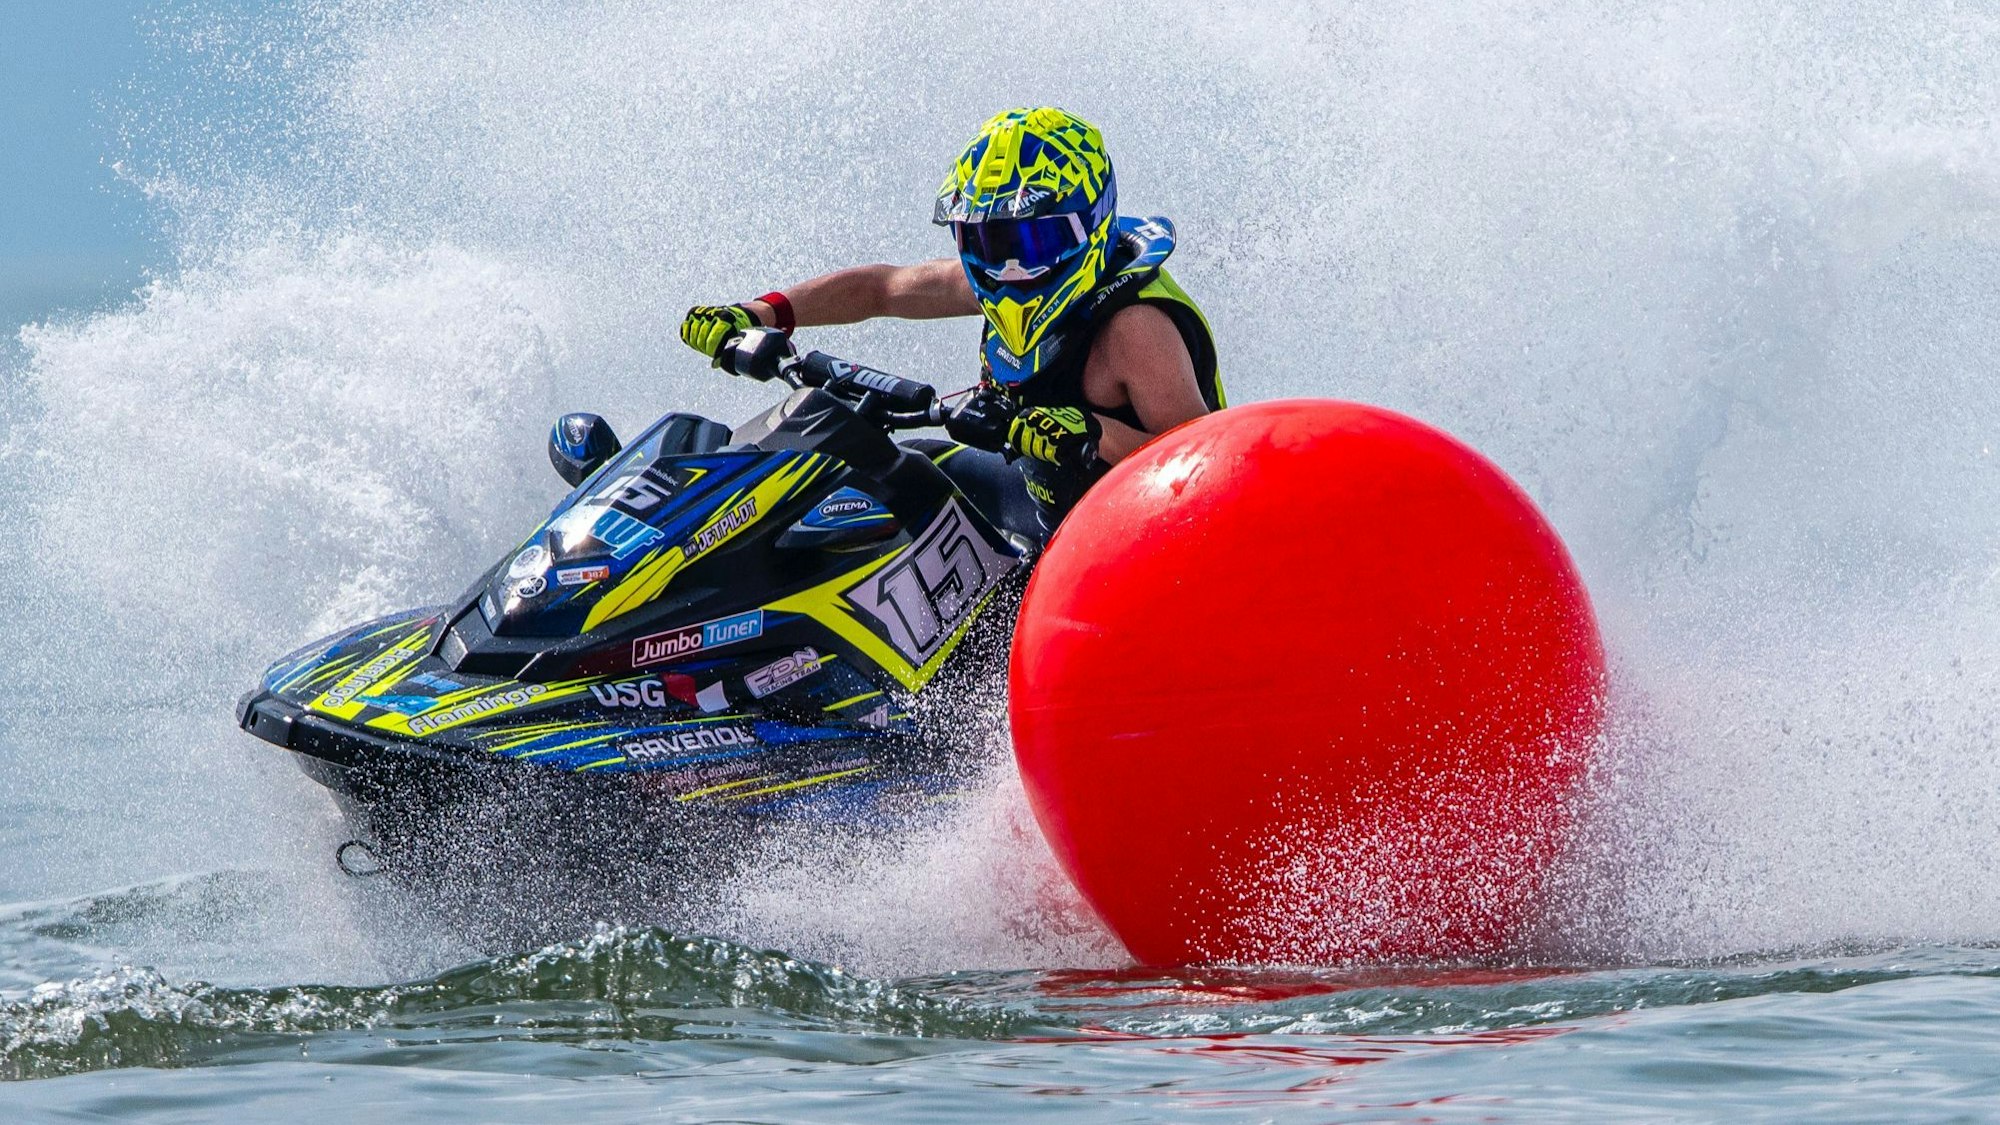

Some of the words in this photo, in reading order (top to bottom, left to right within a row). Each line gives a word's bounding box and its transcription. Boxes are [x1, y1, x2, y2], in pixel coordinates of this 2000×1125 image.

[1032, 299, 1060, 331] AIROH
[996, 346, 1021, 370] RAVENOL
[1028, 410, 1068, 440] FOX
[823, 501, 868, 514] ORTEMA
[699, 498, 757, 552] JETPILOT
[878, 507, 986, 652] 15
[323, 648, 415, 708] Flamingo
[589, 679, 667, 708] USG
[763, 676, 793, 693] RACING
[796, 663, 819, 679] TEAM
[407, 684, 547, 734] Flamingo
[624, 727, 755, 759] RAVENOL
